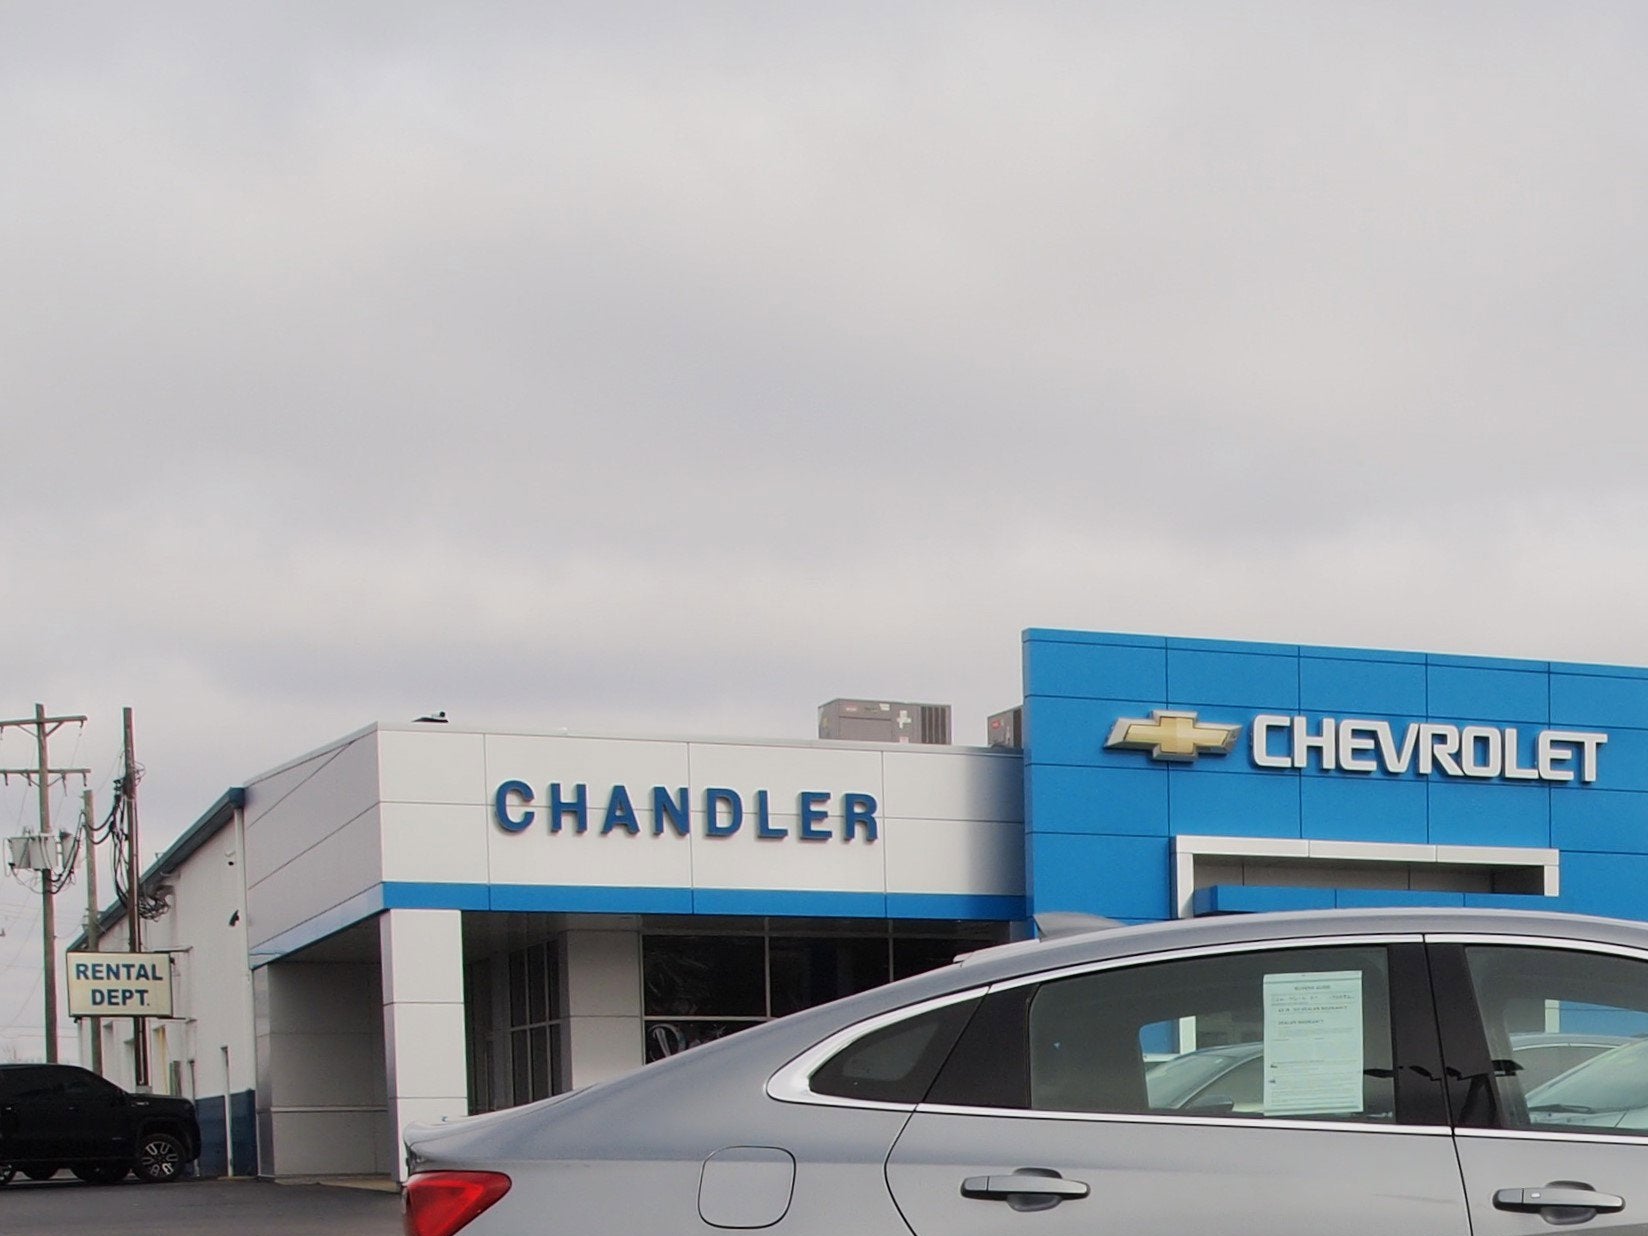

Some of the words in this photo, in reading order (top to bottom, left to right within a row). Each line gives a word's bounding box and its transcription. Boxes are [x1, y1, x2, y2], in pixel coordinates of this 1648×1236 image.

[1252, 714, 1608, 783] CHEVROLET
[494, 780, 879, 842] CHANDLER
[75, 963, 164, 981] RENTAL
[91, 988, 150, 1007] DEPT.
